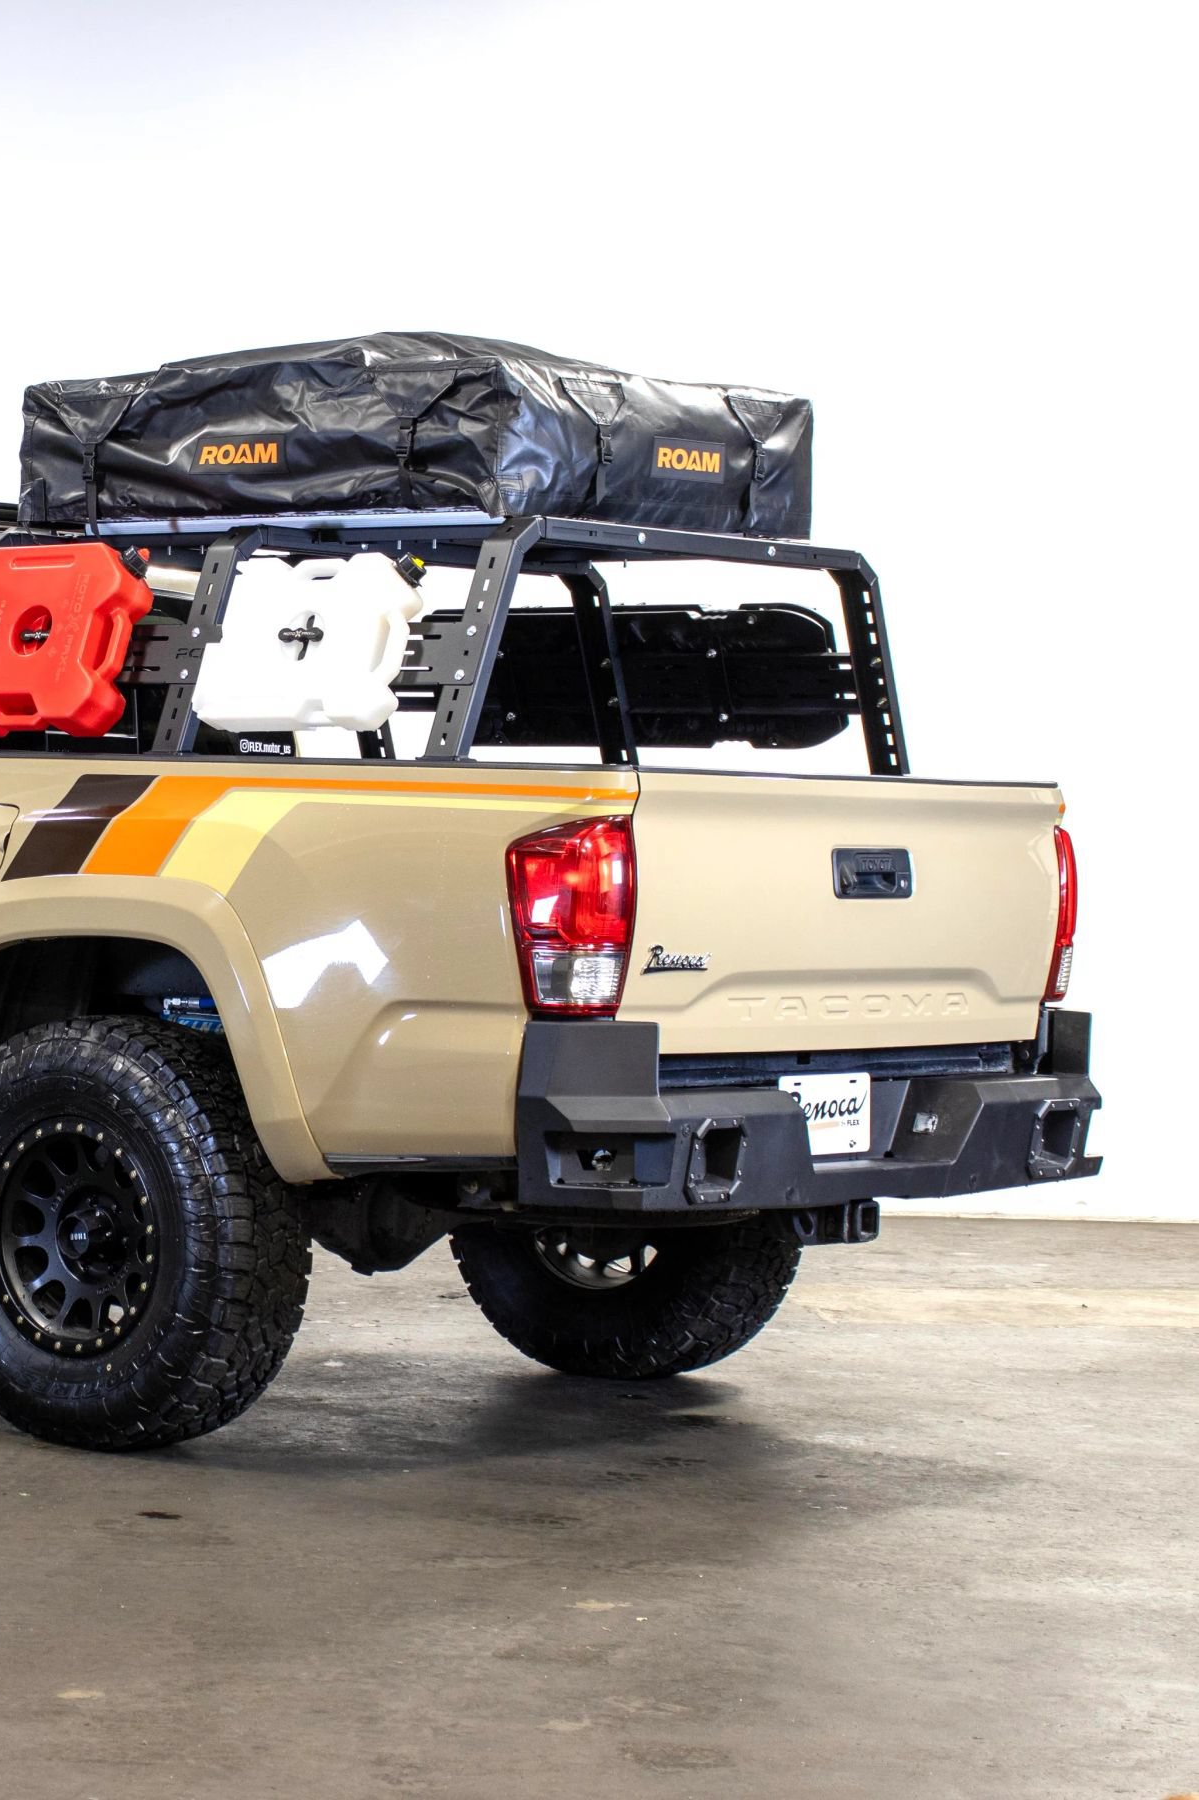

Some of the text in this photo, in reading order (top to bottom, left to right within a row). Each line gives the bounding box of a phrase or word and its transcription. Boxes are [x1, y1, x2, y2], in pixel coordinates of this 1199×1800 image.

[199, 442, 278, 465] ROAM
[657, 447, 720, 474] ROAM
[727, 991, 970, 1022] TACOMA
